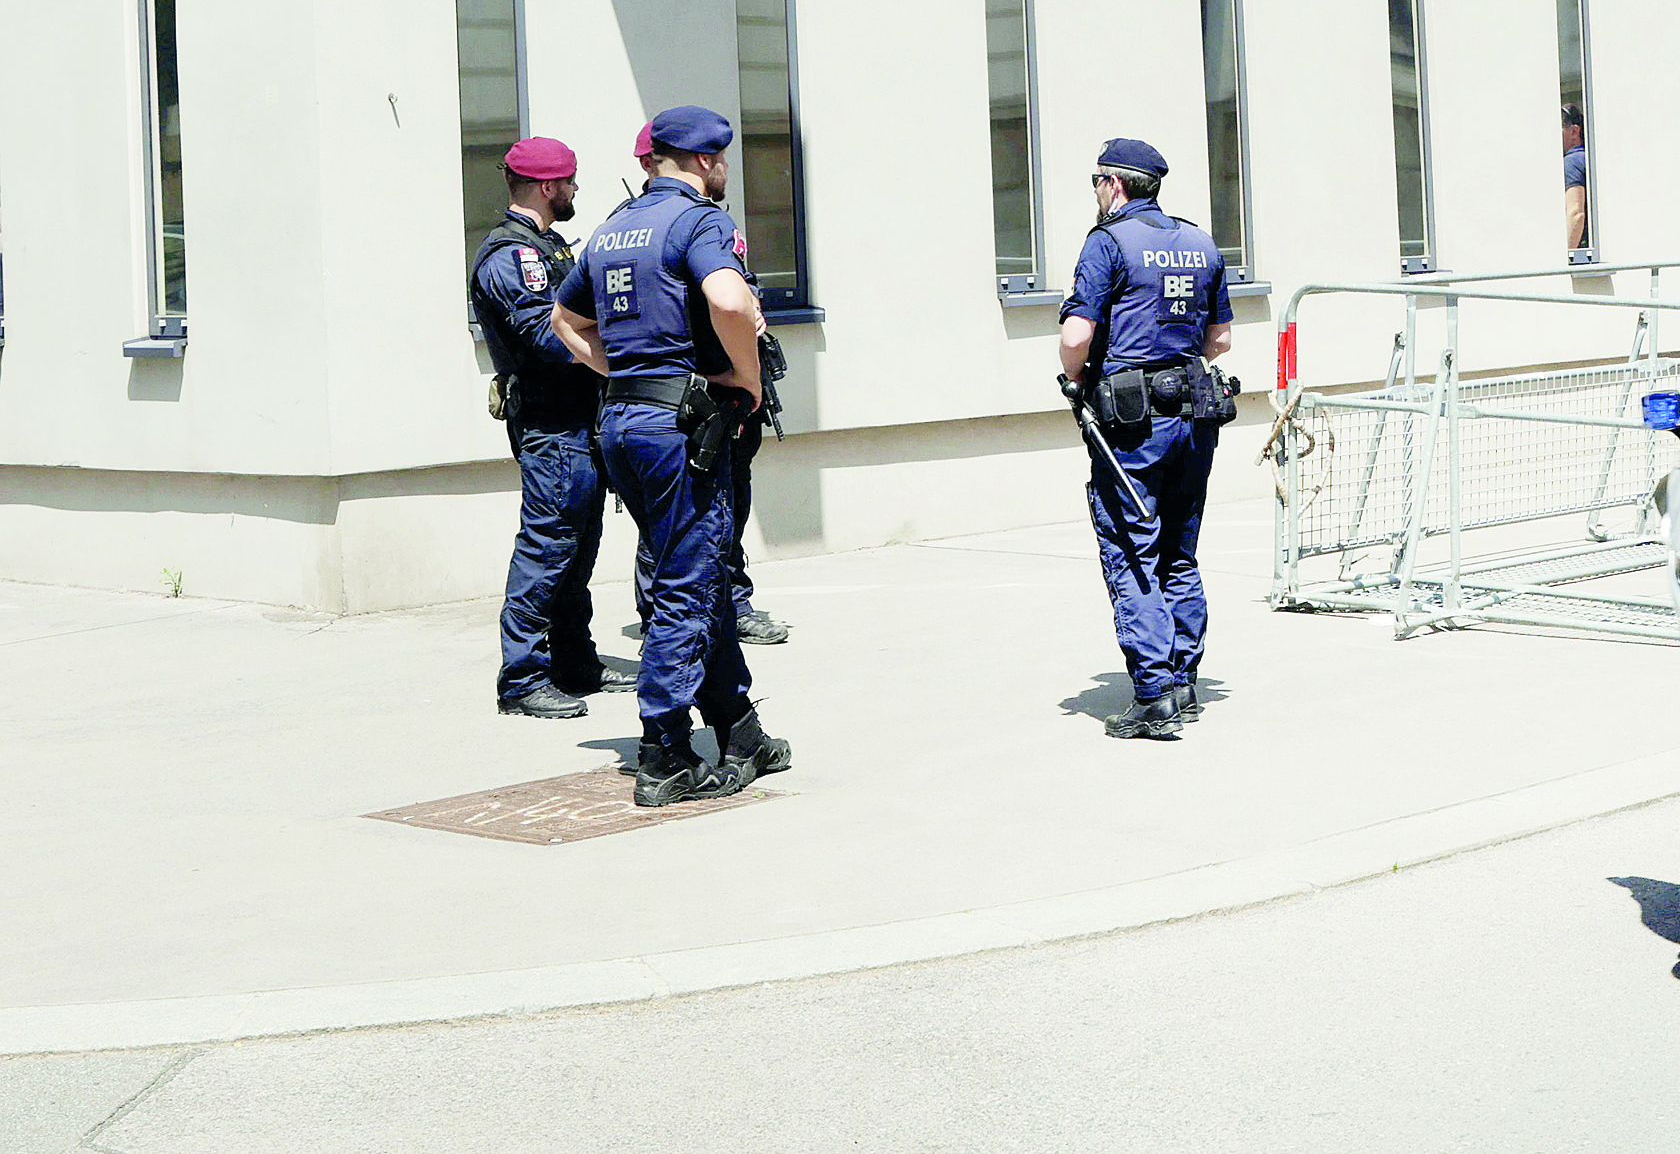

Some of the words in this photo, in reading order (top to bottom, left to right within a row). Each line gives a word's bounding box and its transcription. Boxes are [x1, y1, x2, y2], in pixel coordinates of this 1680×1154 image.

[595, 228, 653, 253] POLIZEI
[1142, 250, 1207, 268] POLIZEI
[606, 267, 633, 295] BE
[1163, 275, 1194, 298] BE
[612, 296, 629, 313] 43
[1169, 300, 1187, 315] 43
